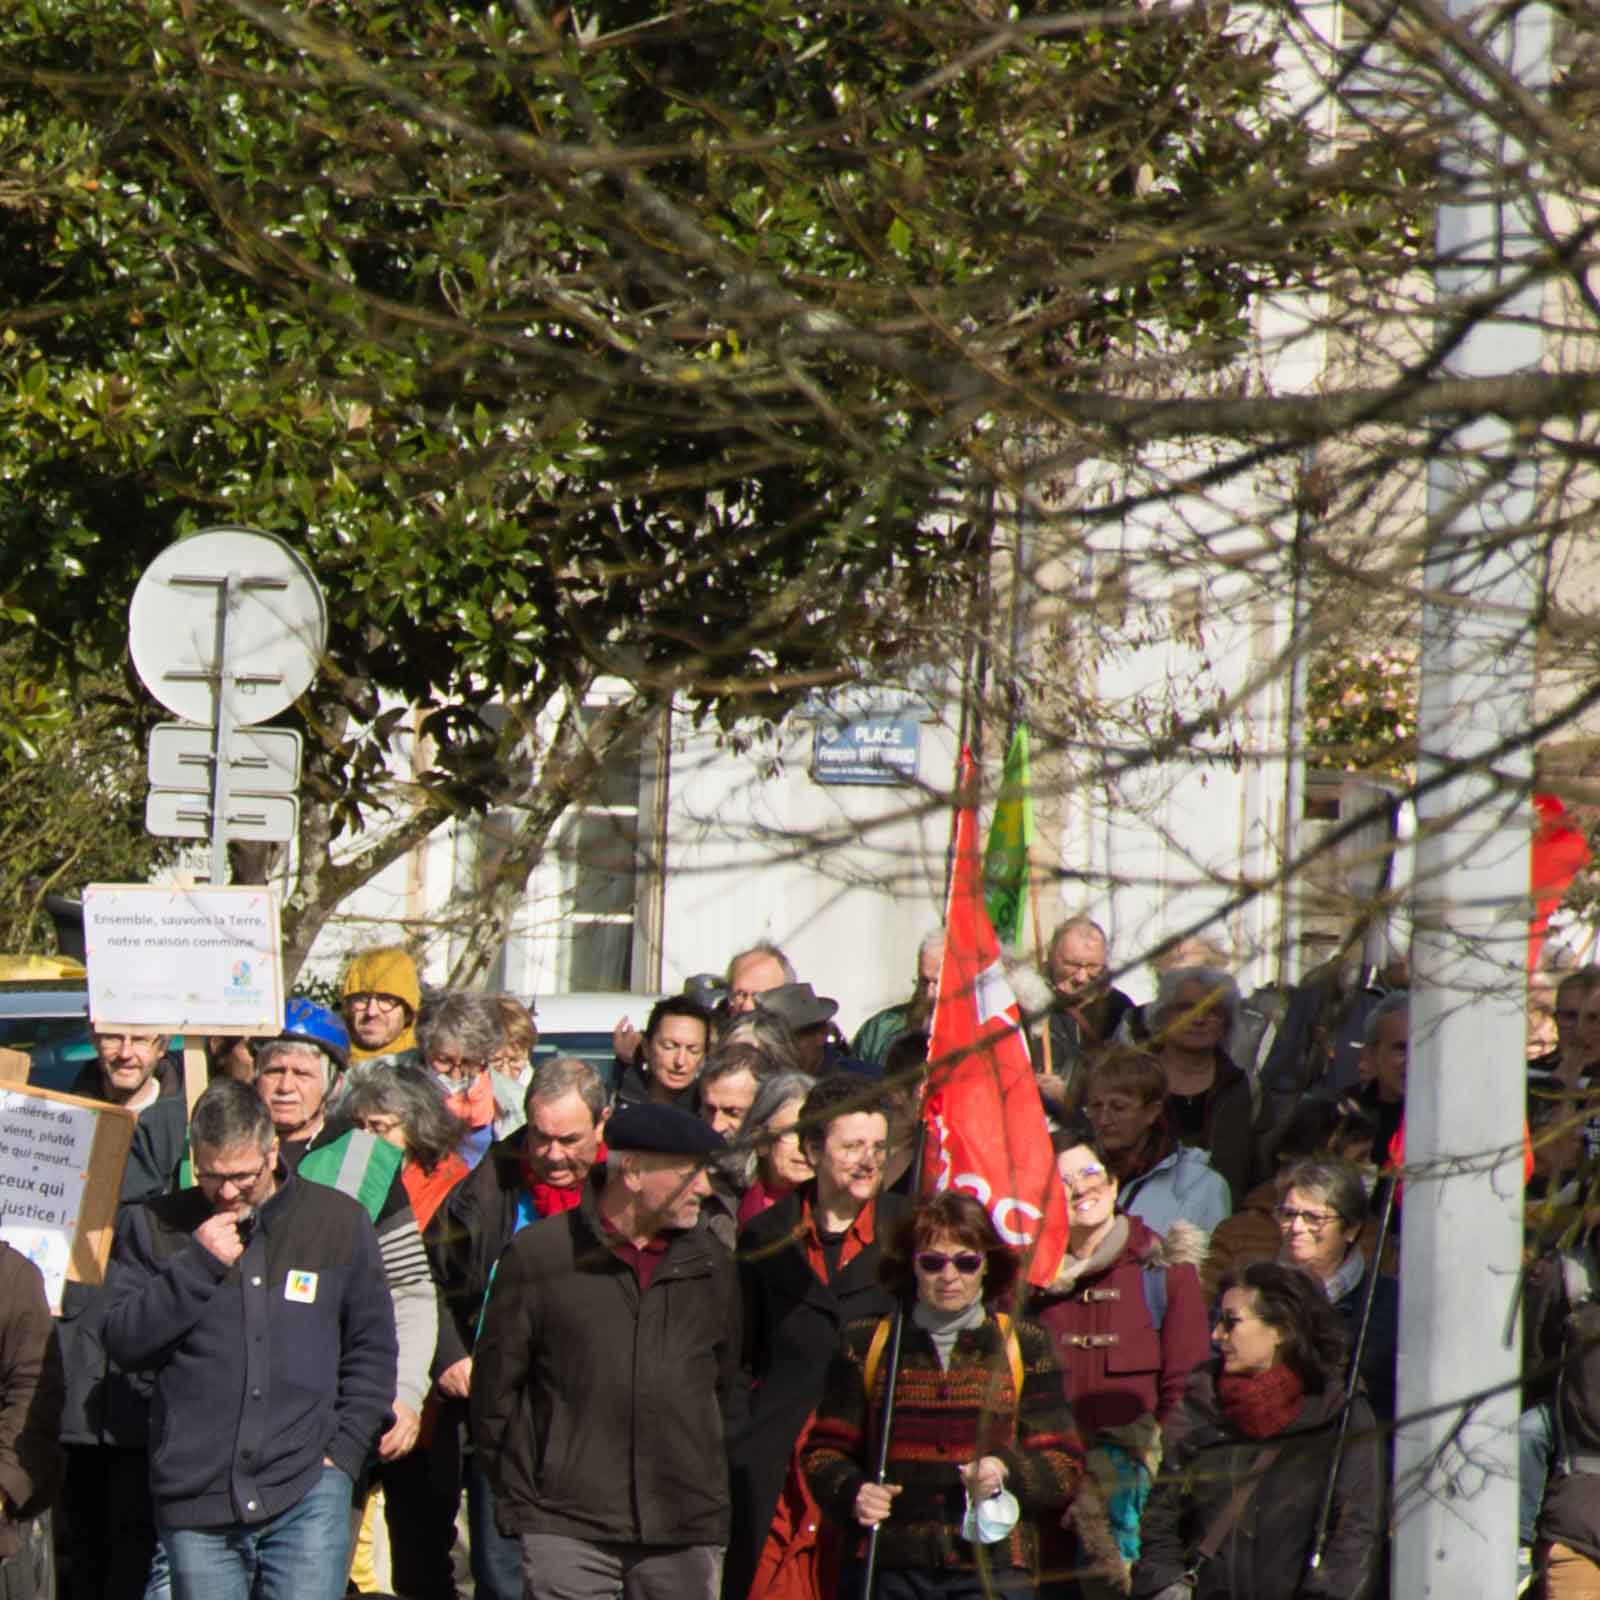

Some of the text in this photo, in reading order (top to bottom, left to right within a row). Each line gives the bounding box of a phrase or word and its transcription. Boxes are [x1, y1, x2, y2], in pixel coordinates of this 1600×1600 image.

[855, 726, 903, 745] PLACE
[94, 913, 158, 928] Ensemble,
[161, 916, 211, 926] sauvons
[213, 914, 225, 926] la
[107, 937, 255, 947] notre maison commune
[57, 1111, 73, 1125] du
[3, 1123, 36, 1141] vient,
[38, 1131, 76, 1147] plutôt
[11, 1146, 31, 1159] qui
[39, 1181, 66, 1198] qui
[1, 1199, 57, 1221] justice
